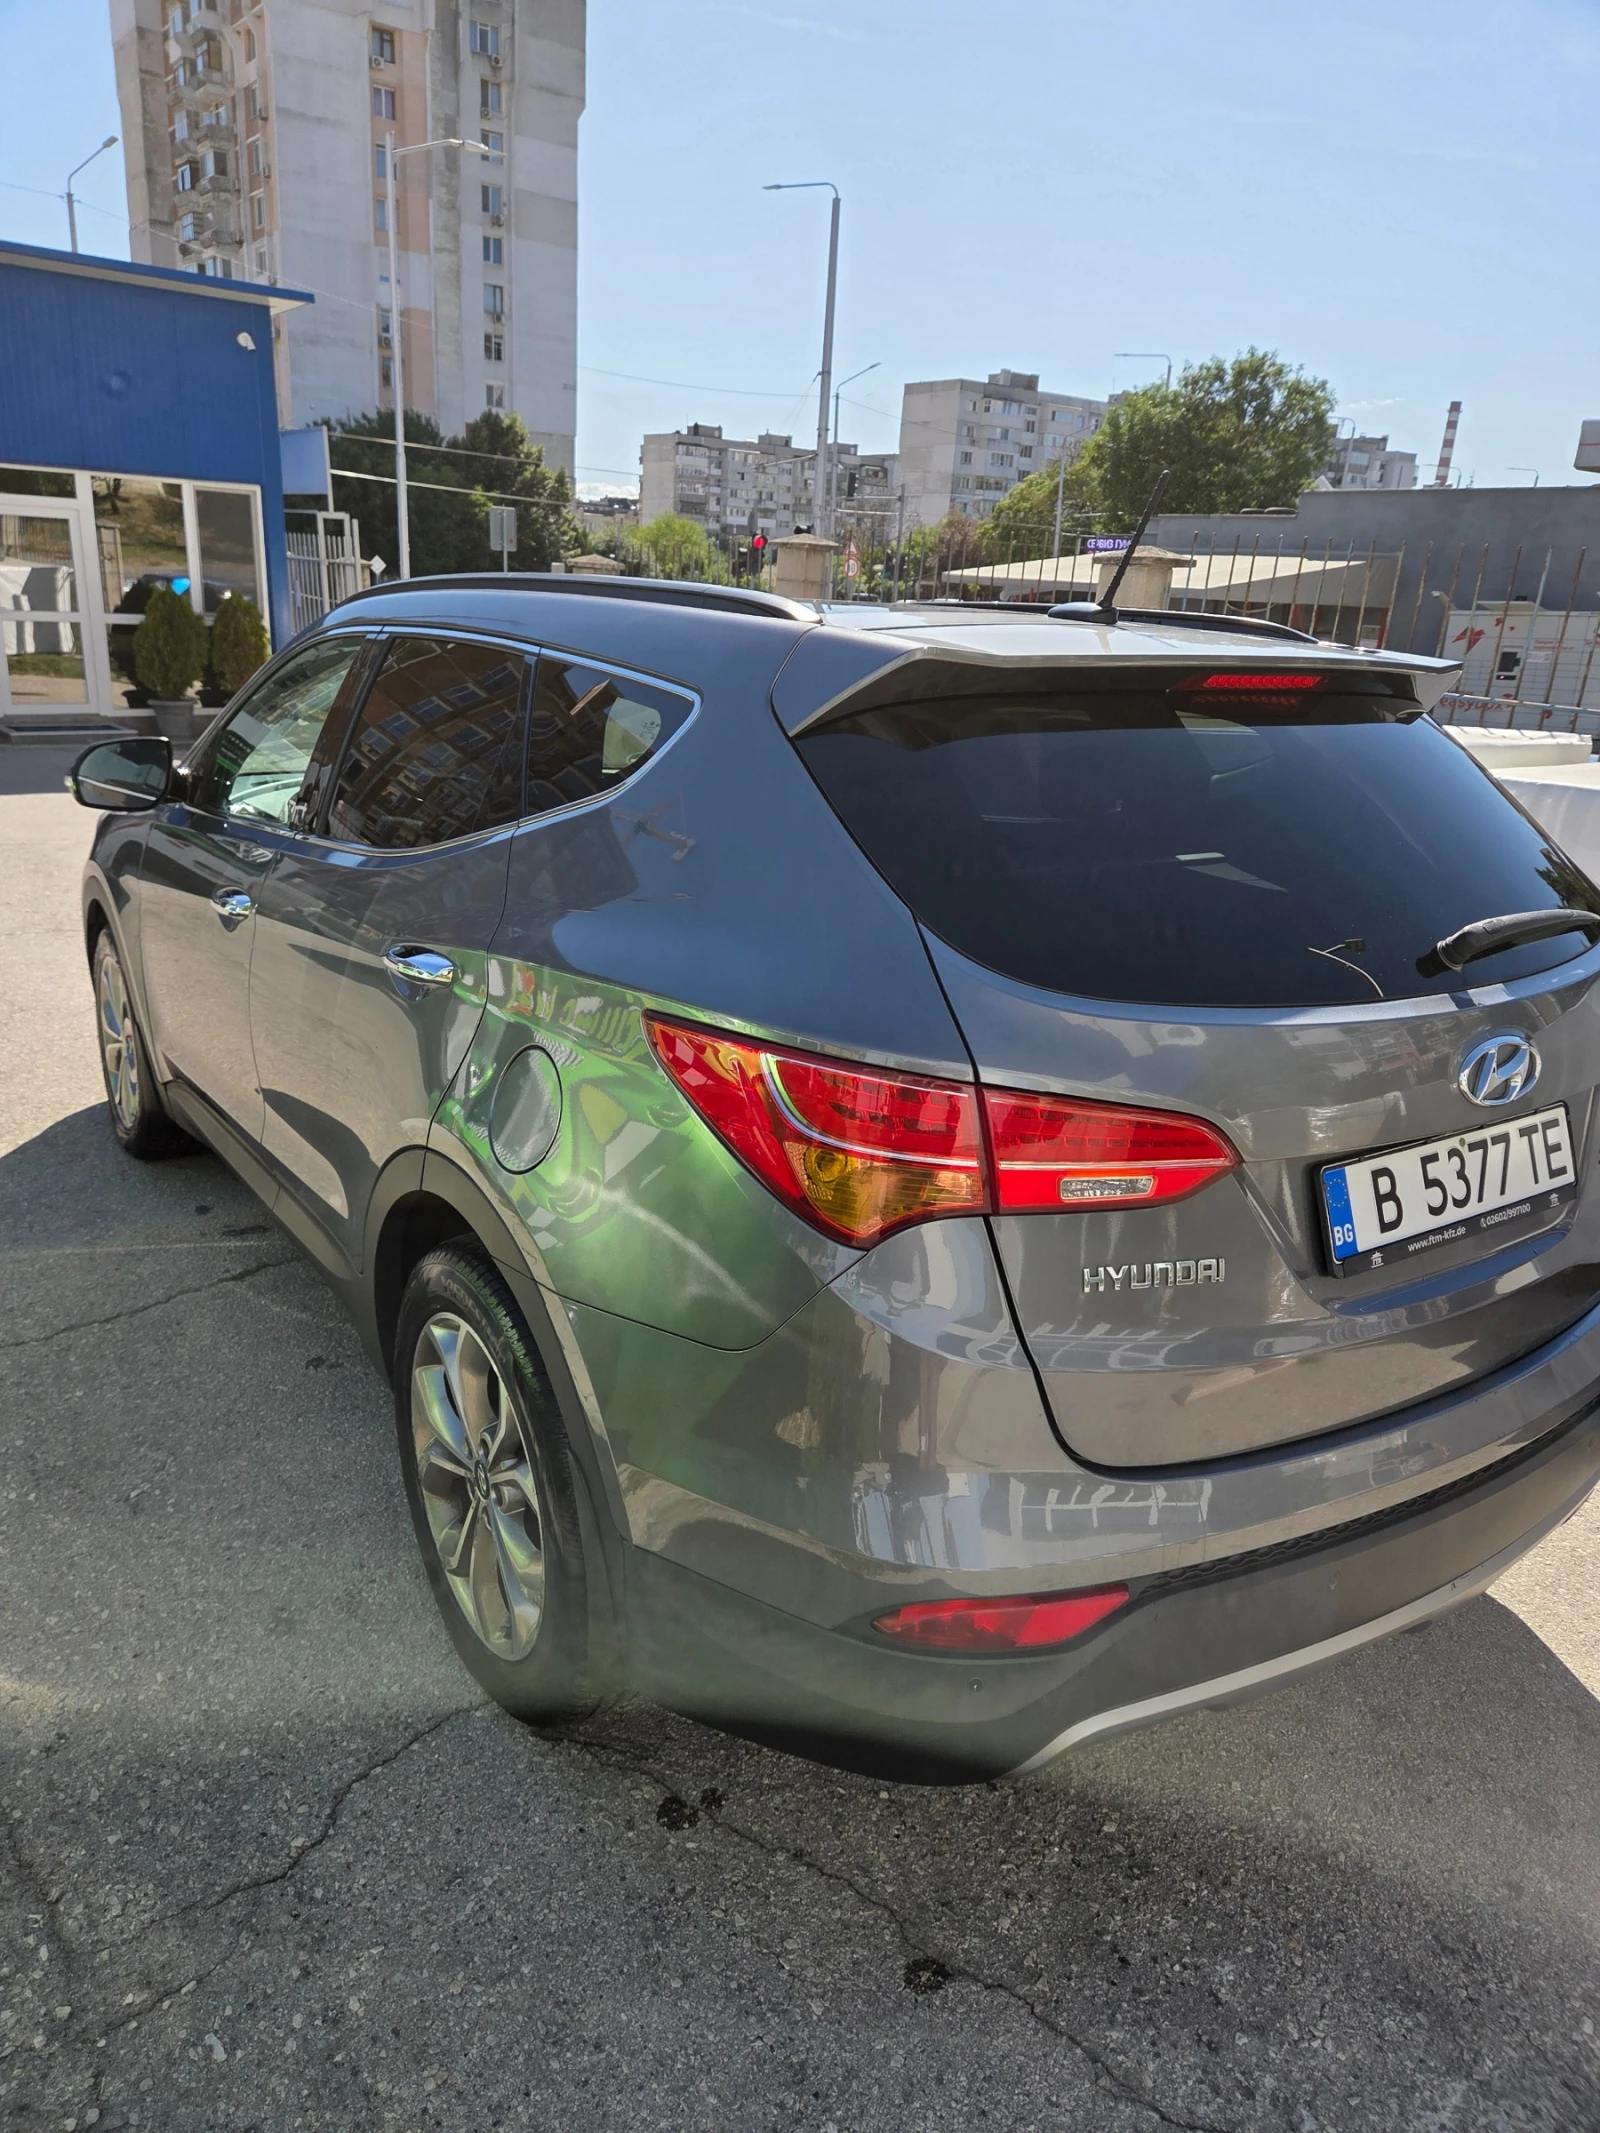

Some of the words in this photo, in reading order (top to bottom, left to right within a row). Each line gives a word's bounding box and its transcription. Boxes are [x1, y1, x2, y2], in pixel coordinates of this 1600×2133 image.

[1371, 1167, 1404, 1234] B
[1420, 1132, 1511, 1217] 5377
[1518, 1118, 1568, 1185] TE
[1333, 1223, 1354, 1247] BG
[1407, 1225, 1467, 1252] www.ftm-kfz.de
[1083, 1257, 1226, 1293] HYUNDAI
